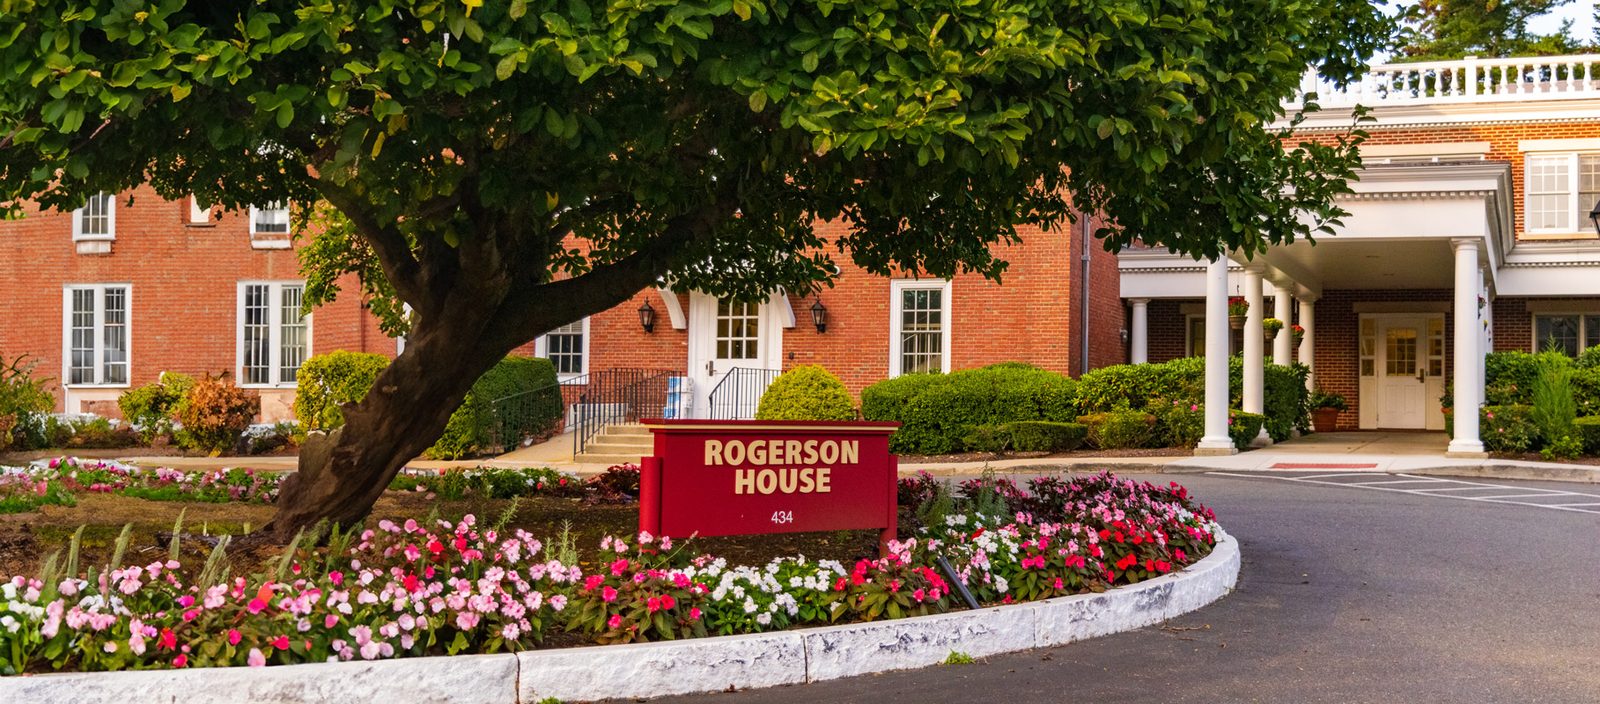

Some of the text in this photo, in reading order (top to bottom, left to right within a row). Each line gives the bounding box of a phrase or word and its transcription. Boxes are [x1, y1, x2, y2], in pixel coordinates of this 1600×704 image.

[704, 440, 859, 466] ROGERSON
[735, 468, 831, 495] HOUSE
[771, 510, 793, 524] 434
